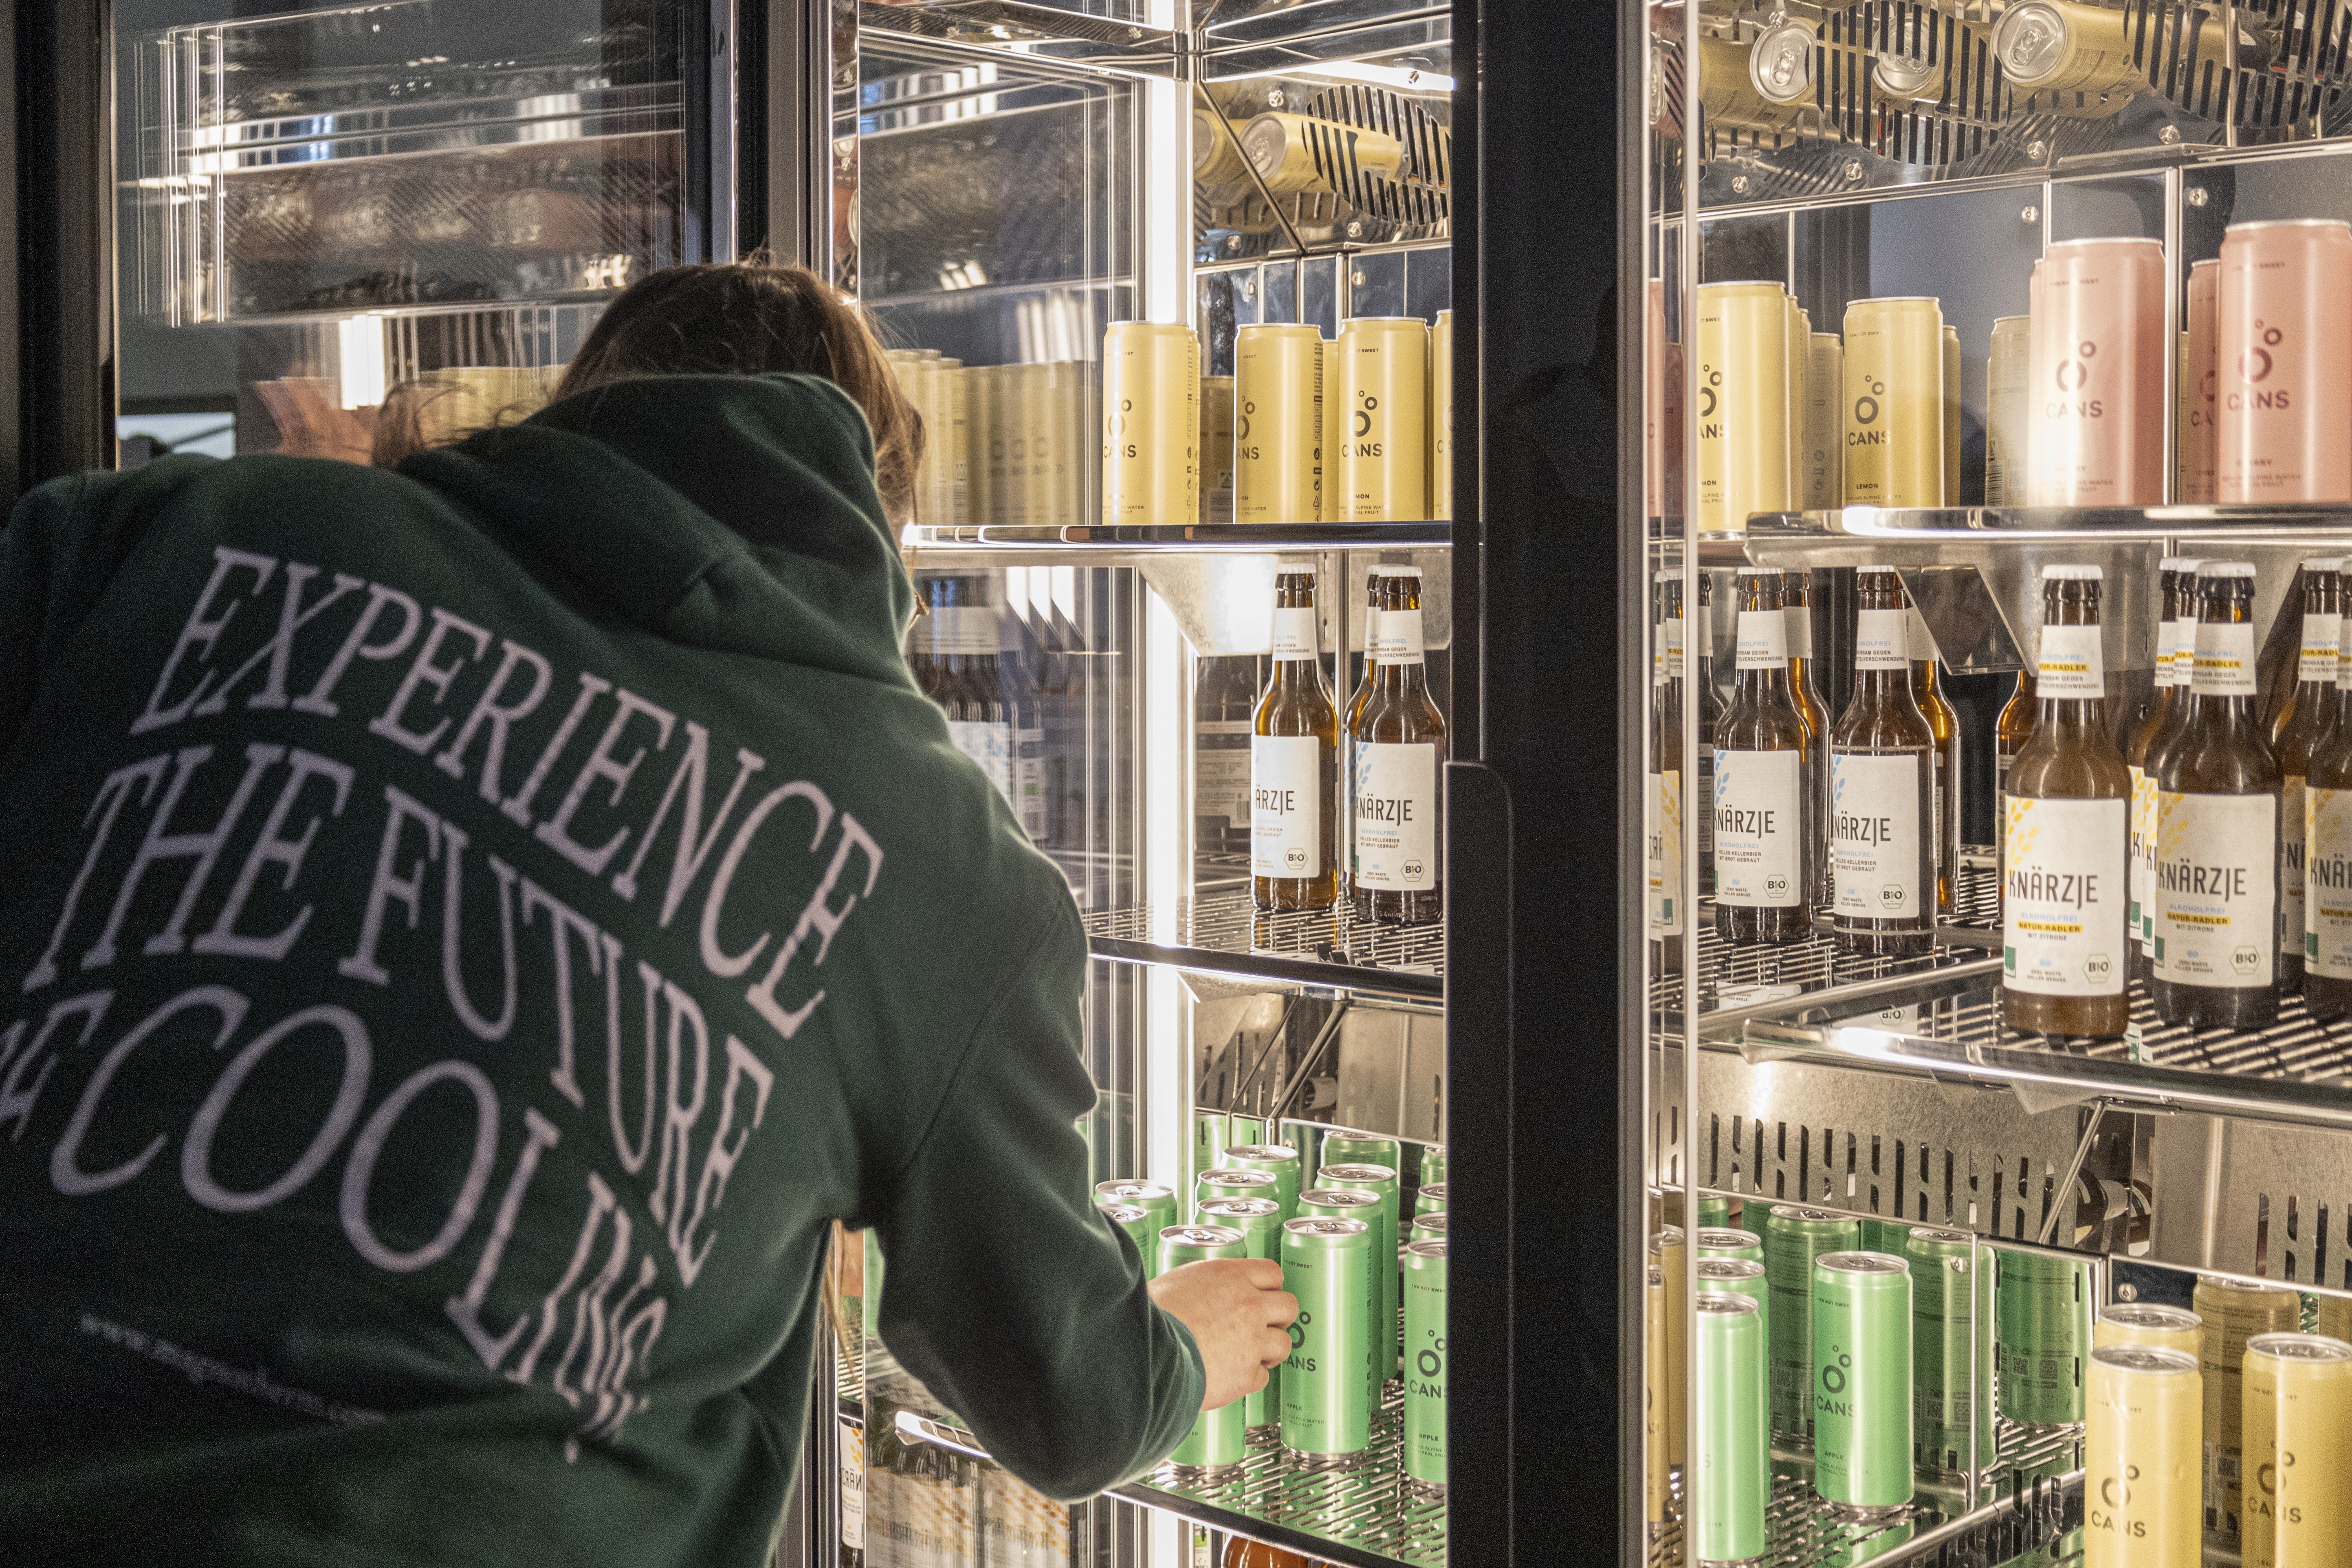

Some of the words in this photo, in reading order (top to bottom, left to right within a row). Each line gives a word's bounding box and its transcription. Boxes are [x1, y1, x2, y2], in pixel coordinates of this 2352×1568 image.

[1698, 423, 1730, 439] ANS
[1848, 430, 1891, 446] CANS
[1237, 446, 1260, 460] ANS
[1342, 443, 1383, 457] CANS
[130, 545, 885, 1039] EXPERIENCE
[1256, 784, 1295, 816] ÄRZJE
[1833, 810, 1892, 848] NÄRZJE
[1837, 849, 1874, 858] ALKOHOLFREI
[2009, 864, 2099, 912] KNÄRZJE
[2158, 857, 2247, 904] KNÄRZJE
[2021, 912, 2078, 923] ALKOHOLFREI
[2167, 913, 2229, 925] NATUR-RADLER
[2018, 921, 2081, 933] NATUR-RADLER
[23, 741, 355, 992] THE
[337, 786, 775, 1288] FUTURE
[0, 988, 116, 1143] F
[1284, 1355, 1317, 1372] ANS
[1286, 1402, 1303, 1411] APPLE
[1816, 1394, 1858, 1419] CANS
[1419, 1433, 1439, 1442] APPLE
[1824, 1450, 1844, 1460] APPLE
